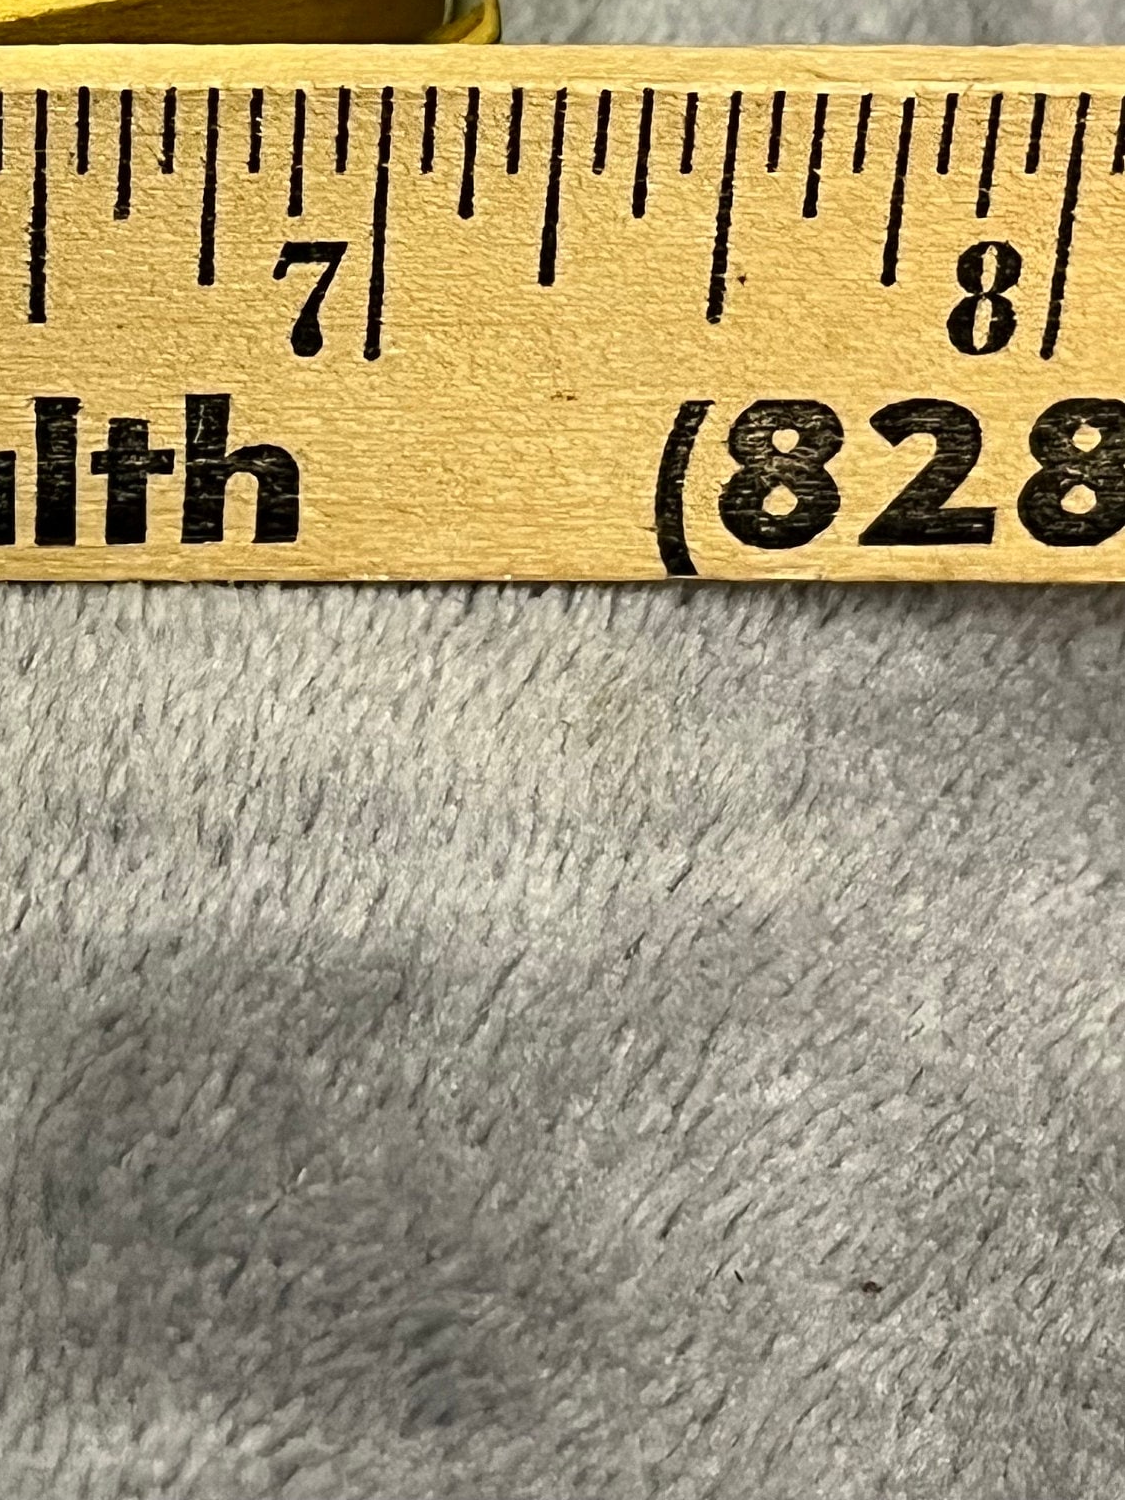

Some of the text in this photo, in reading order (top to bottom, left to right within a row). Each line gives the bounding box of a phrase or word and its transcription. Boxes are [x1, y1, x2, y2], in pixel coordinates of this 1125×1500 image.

[272, 240, 349, 358] 7
[946, 240, 1023, 356] 8
[653, 397, 1125, 577] (828
